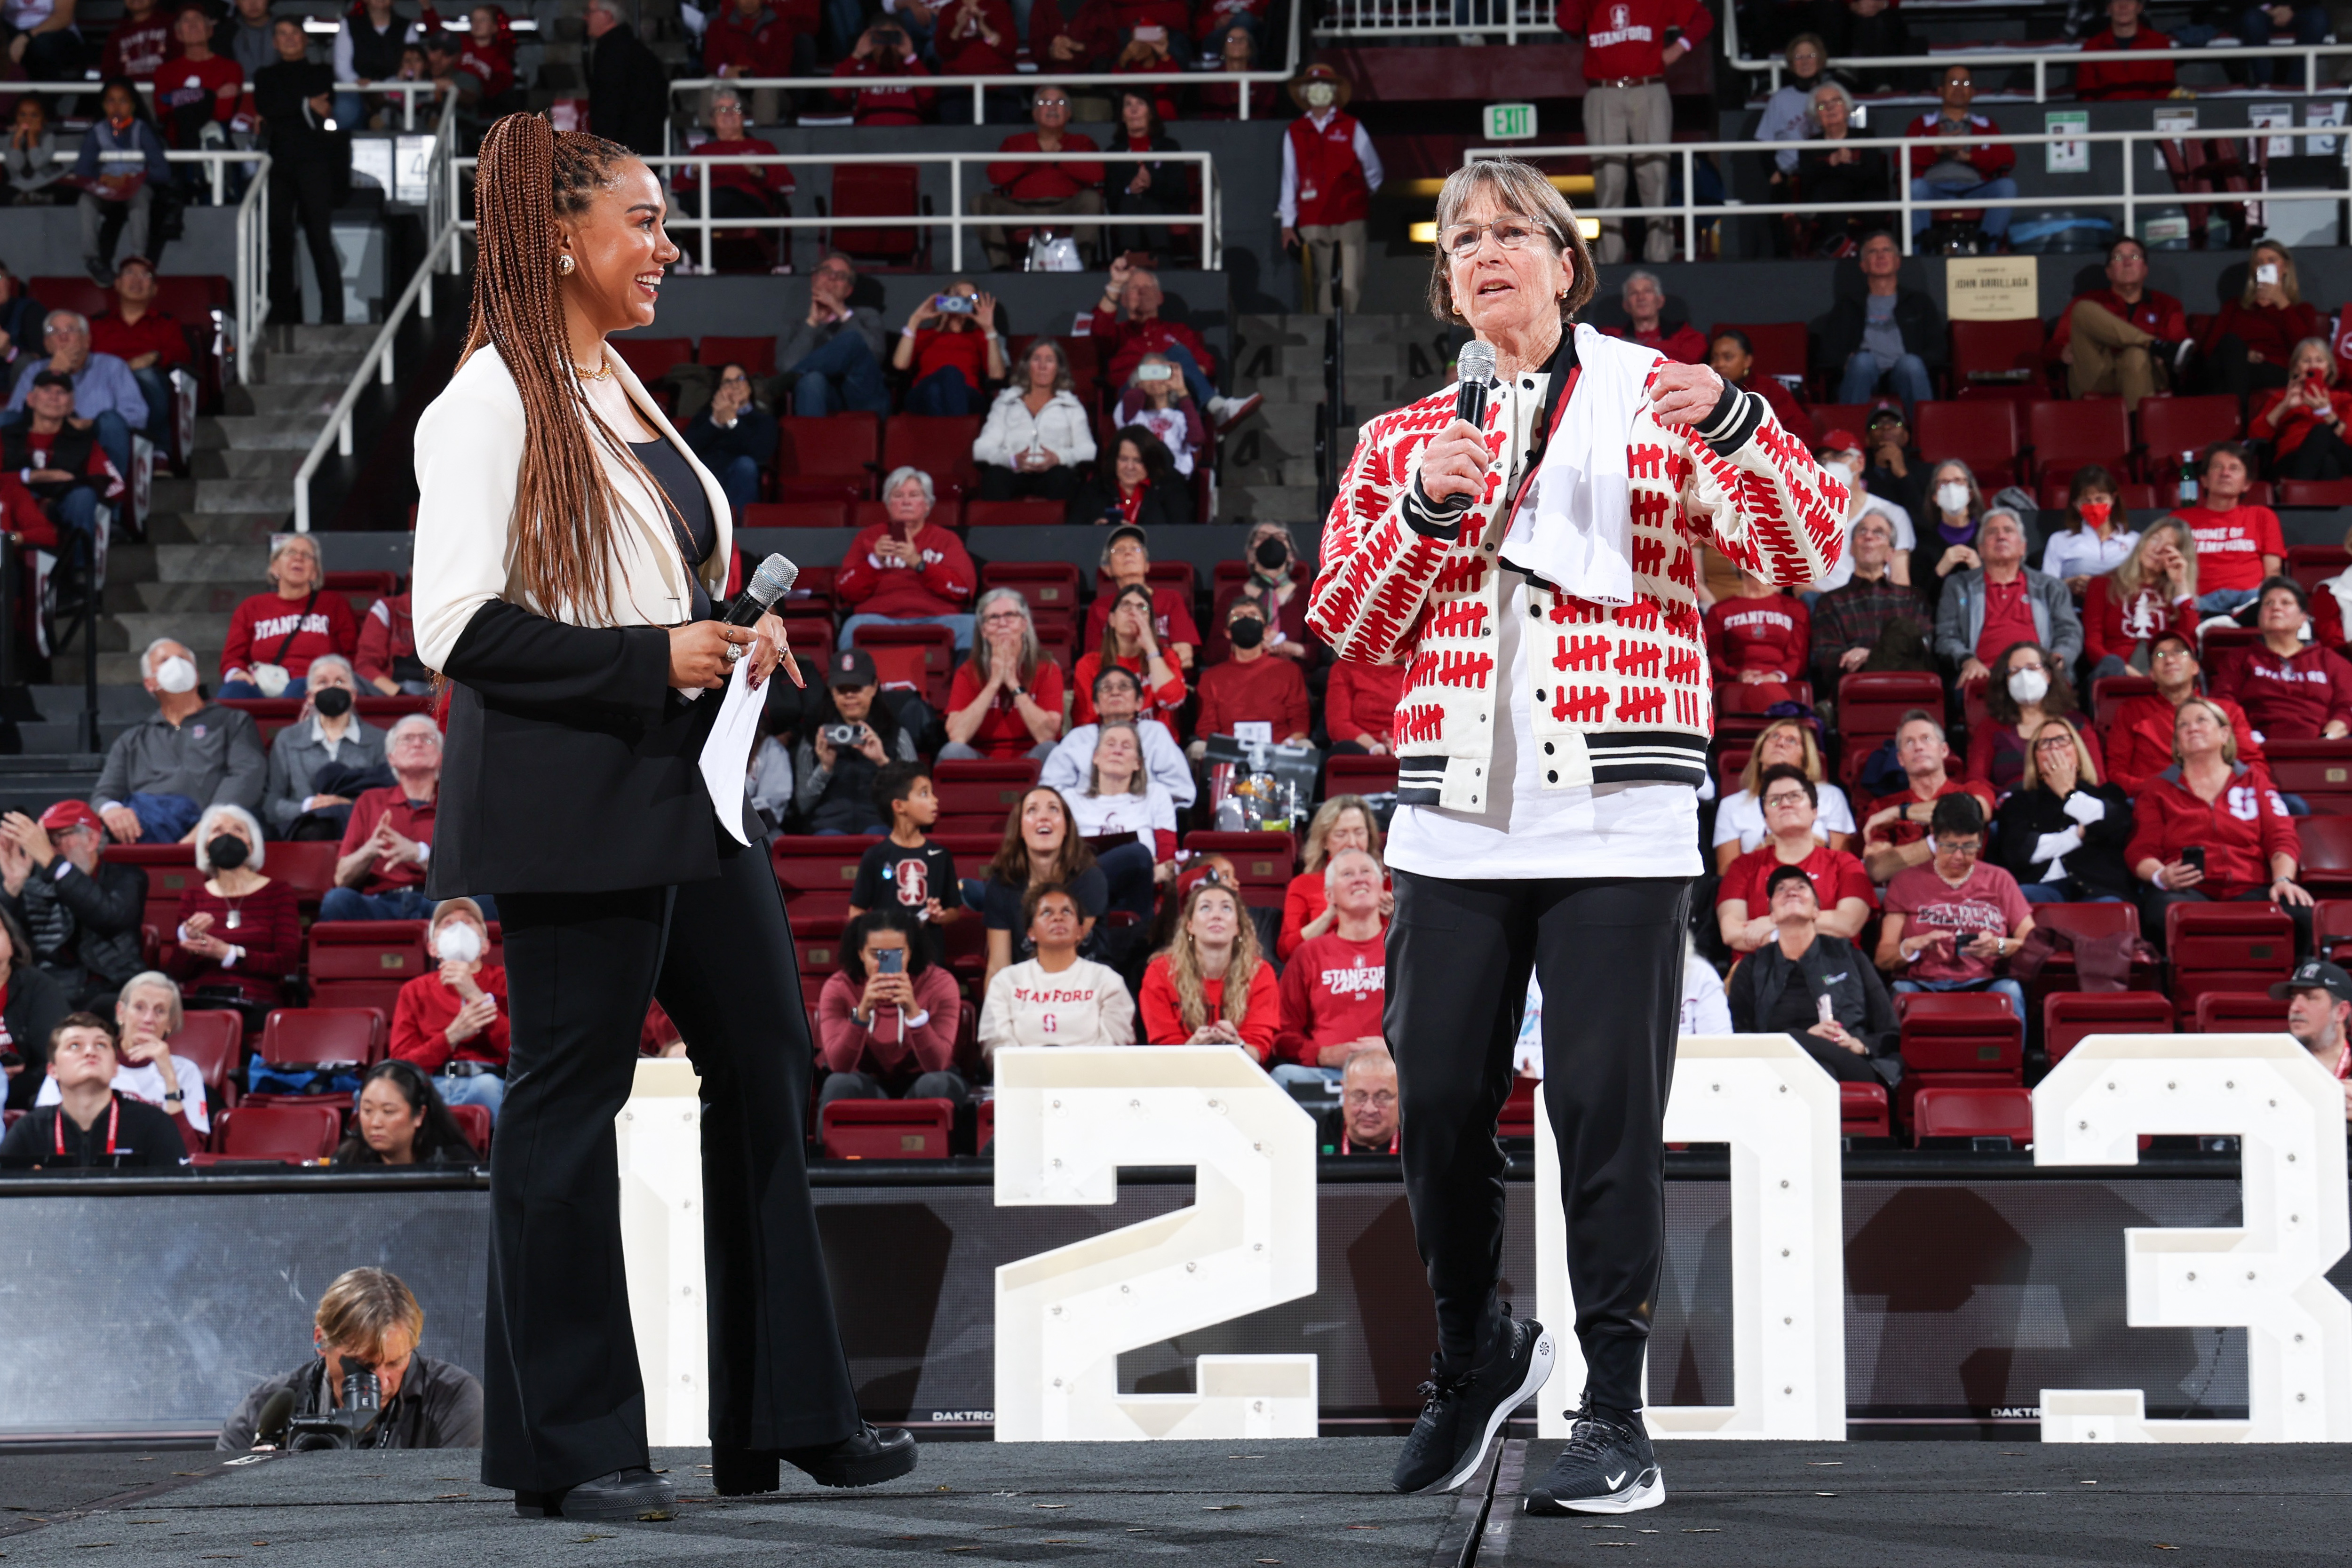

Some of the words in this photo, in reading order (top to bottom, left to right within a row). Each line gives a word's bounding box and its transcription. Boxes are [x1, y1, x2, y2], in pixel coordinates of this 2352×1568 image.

[1589, 25, 1653, 48] STANFORD
[1493, 106, 1529, 135] EXIT
[2196, 538, 2257, 553] AMPIONS
[1724, 610, 1793, 631] STANFORD
[1015, 988, 1094, 1003] STANFORD
[994, 1044, 1319, 1442] 2
[2032, 1033, 2352, 1443] 3
